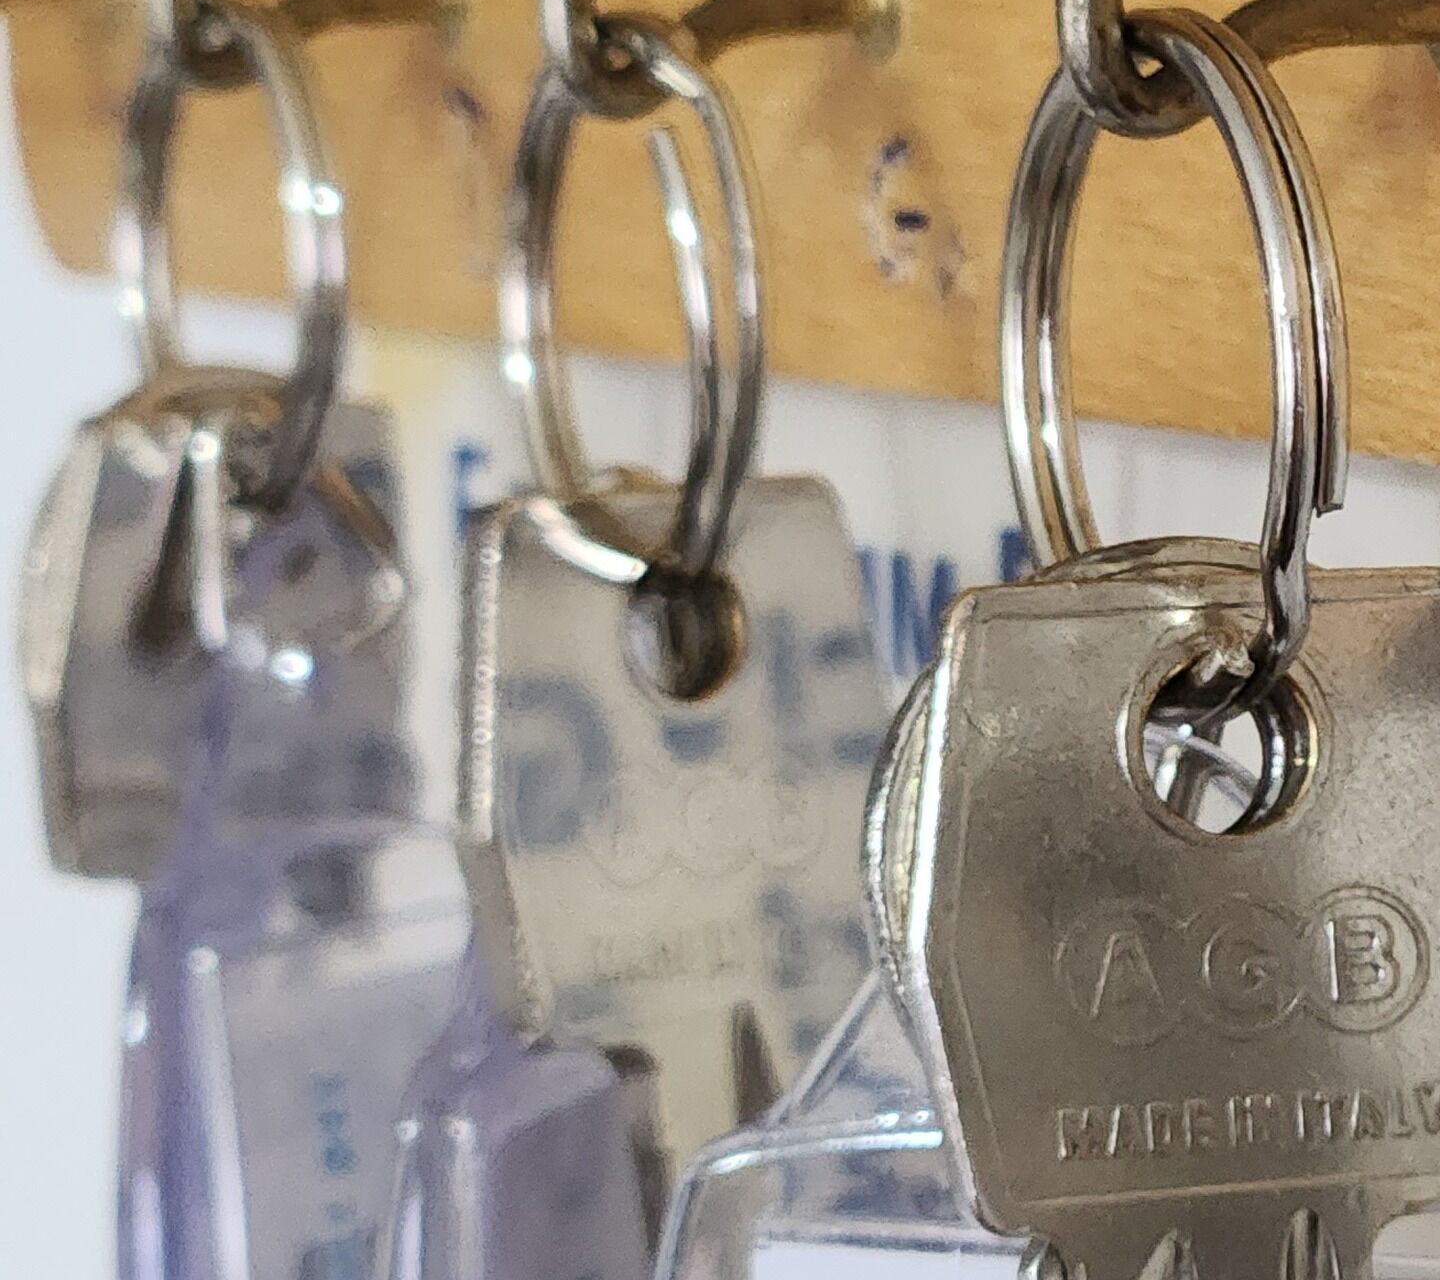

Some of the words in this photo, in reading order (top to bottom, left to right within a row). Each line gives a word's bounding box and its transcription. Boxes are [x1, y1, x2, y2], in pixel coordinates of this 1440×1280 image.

[1078, 898, 1425, 1032] AGB
[1055, 1097, 1212, 1162] MADE
[1226, 1091, 1278, 1150] IN
